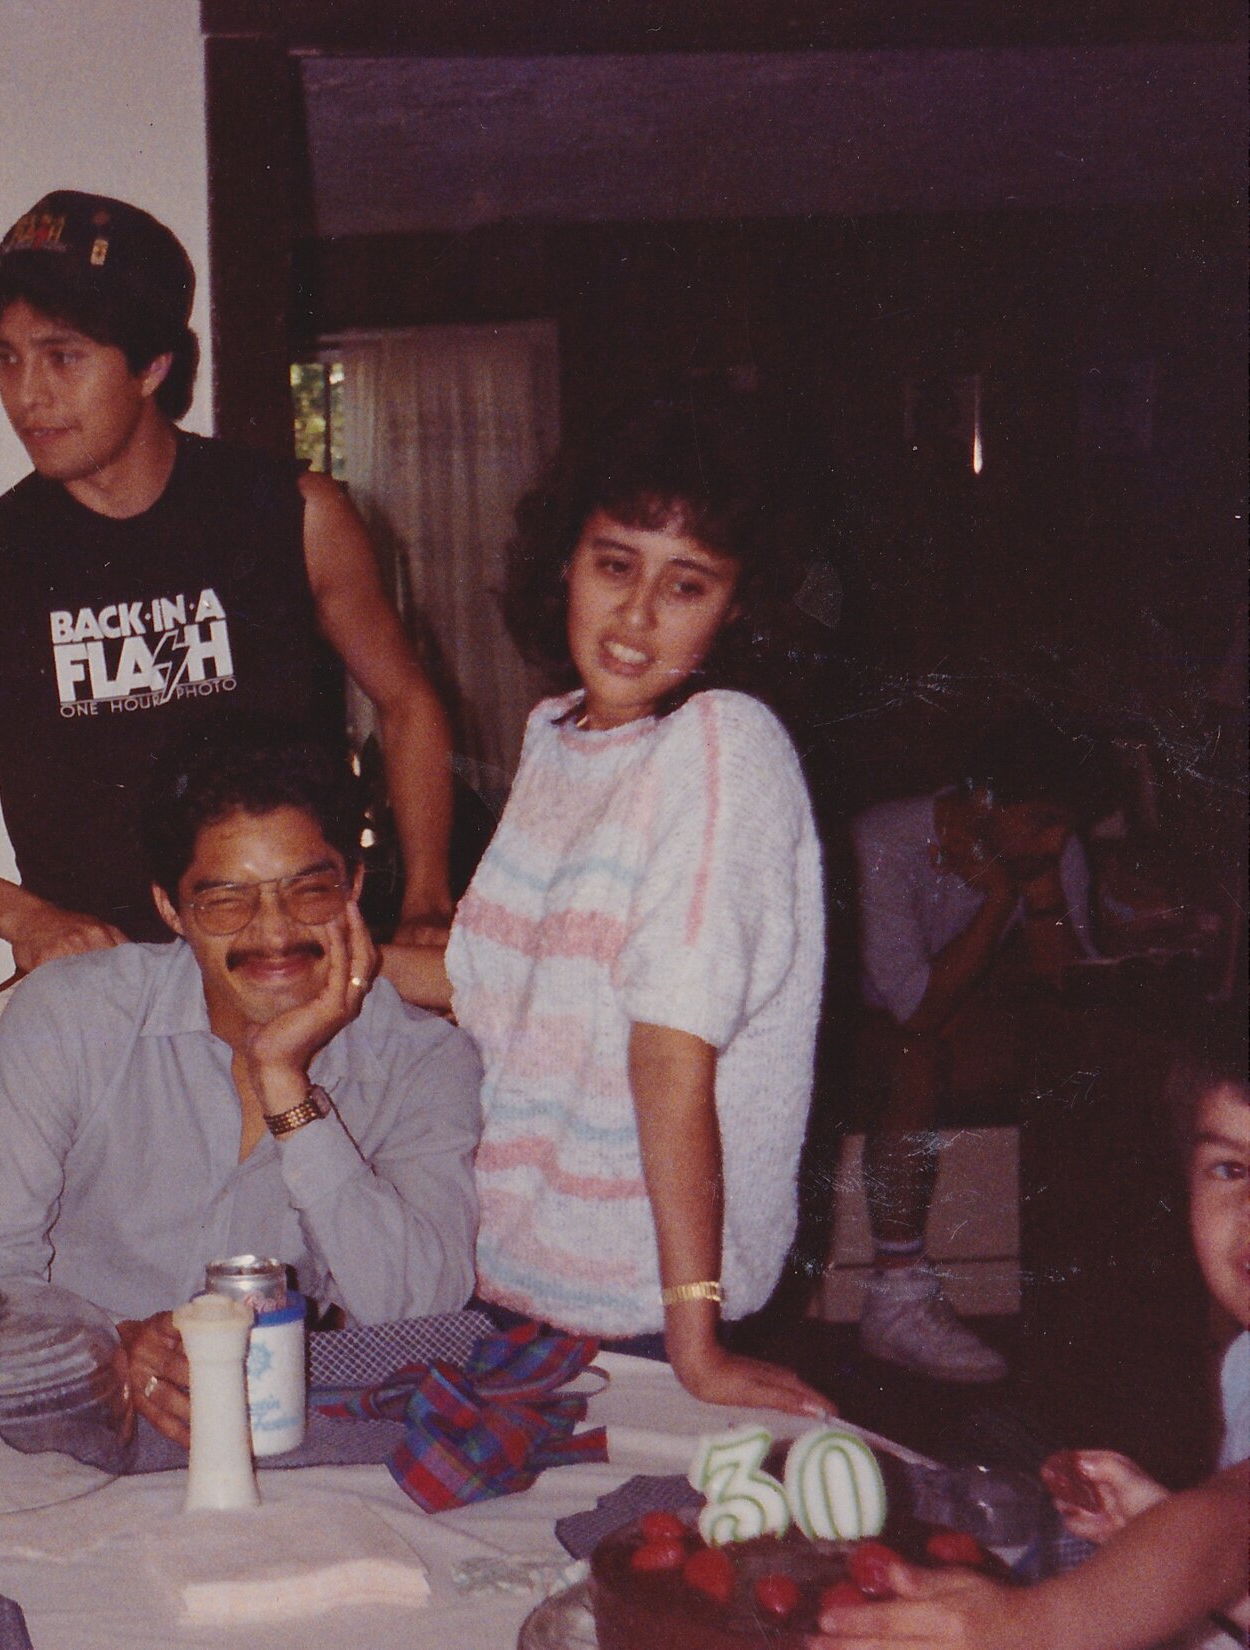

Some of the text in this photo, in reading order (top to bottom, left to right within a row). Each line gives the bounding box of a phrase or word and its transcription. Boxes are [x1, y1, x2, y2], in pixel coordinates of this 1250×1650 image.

[60, 677, 238, 718] ONE HOUR PHOTO
[686, 1424, 888, 1548] 30
